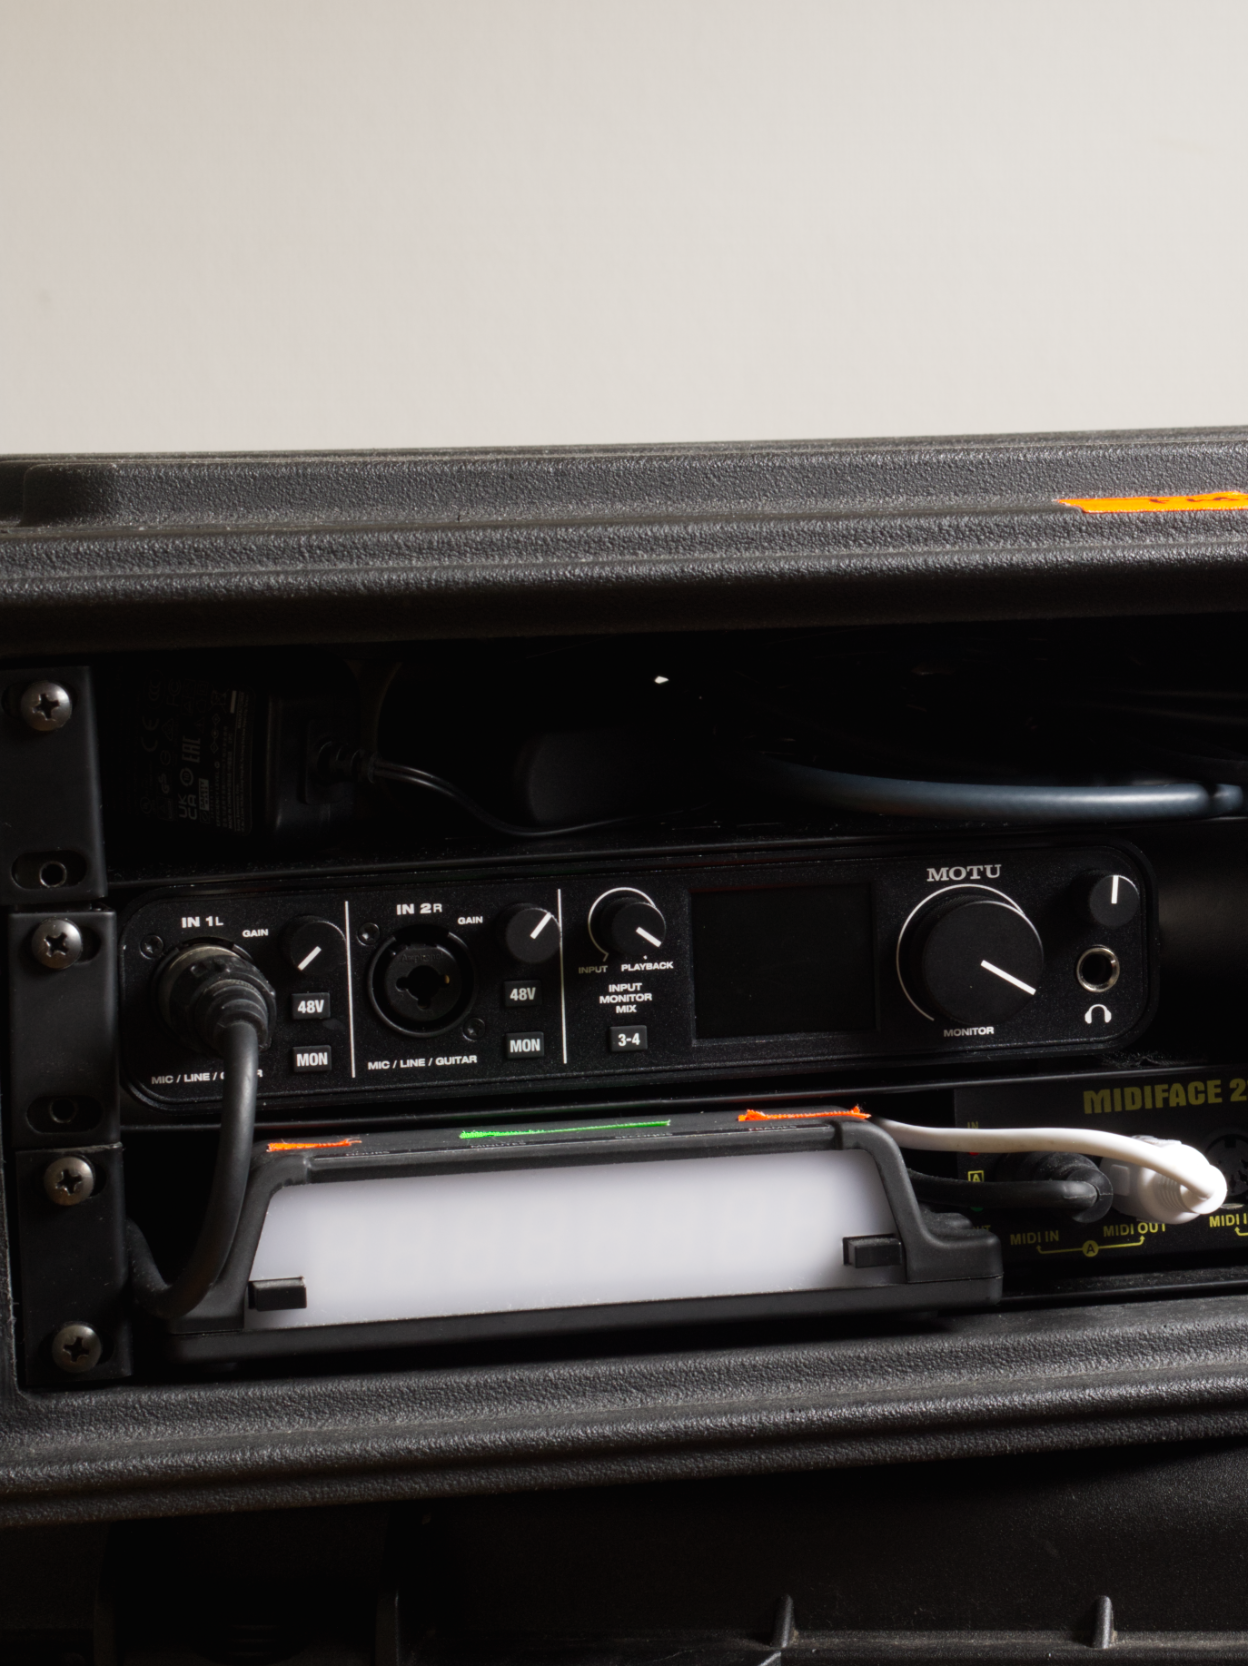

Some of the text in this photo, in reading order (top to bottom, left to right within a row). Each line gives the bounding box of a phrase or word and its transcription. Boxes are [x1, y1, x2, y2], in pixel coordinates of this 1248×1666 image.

[141, 714, 159, 752] CE
[178, 793, 189, 818] UK
[186, 794, 198, 821] CA
[926, 864, 1002, 882] MOTU
[396, 903, 443, 915] IN 2R
[181, 916, 224, 928] IN 1L
[457, 915, 484, 925] GAIN
[242, 928, 269, 938] GAIN
[578, 961, 674, 974] INPUT PLAYBACK
[509, 987, 536, 1001] 48V
[608, 982, 642, 993] INPUT
[599, 993, 653, 1004] MONITOR
[297, 1000, 325, 1014] 48V
[615, 1004, 637, 1014] MIX
[943, 1026, 995, 1038] MONITOR
[509, 1038, 540, 1053] MON
[618, 1032, 641, 1047] 3-4
[296, 1052, 329, 1067] MON
[367, 1060, 391, 1071] MIC
[400, 1058, 426, 1069] LINE
[435, 1055, 478, 1067] GUITAR
[151, 1075, 174, 1085] MIC
[183, 1072, 211, 1083] LINE
[1082, 1079, 1223, 1115] MIDIFACE
[1208, 1213, 1240, 1228] MIDI
[1103, 1223, 1135, 1237] MIDI
[1010, 1230, 1060, 1246] MIDI IN
[1085, 1243, 1096, 1255] A
